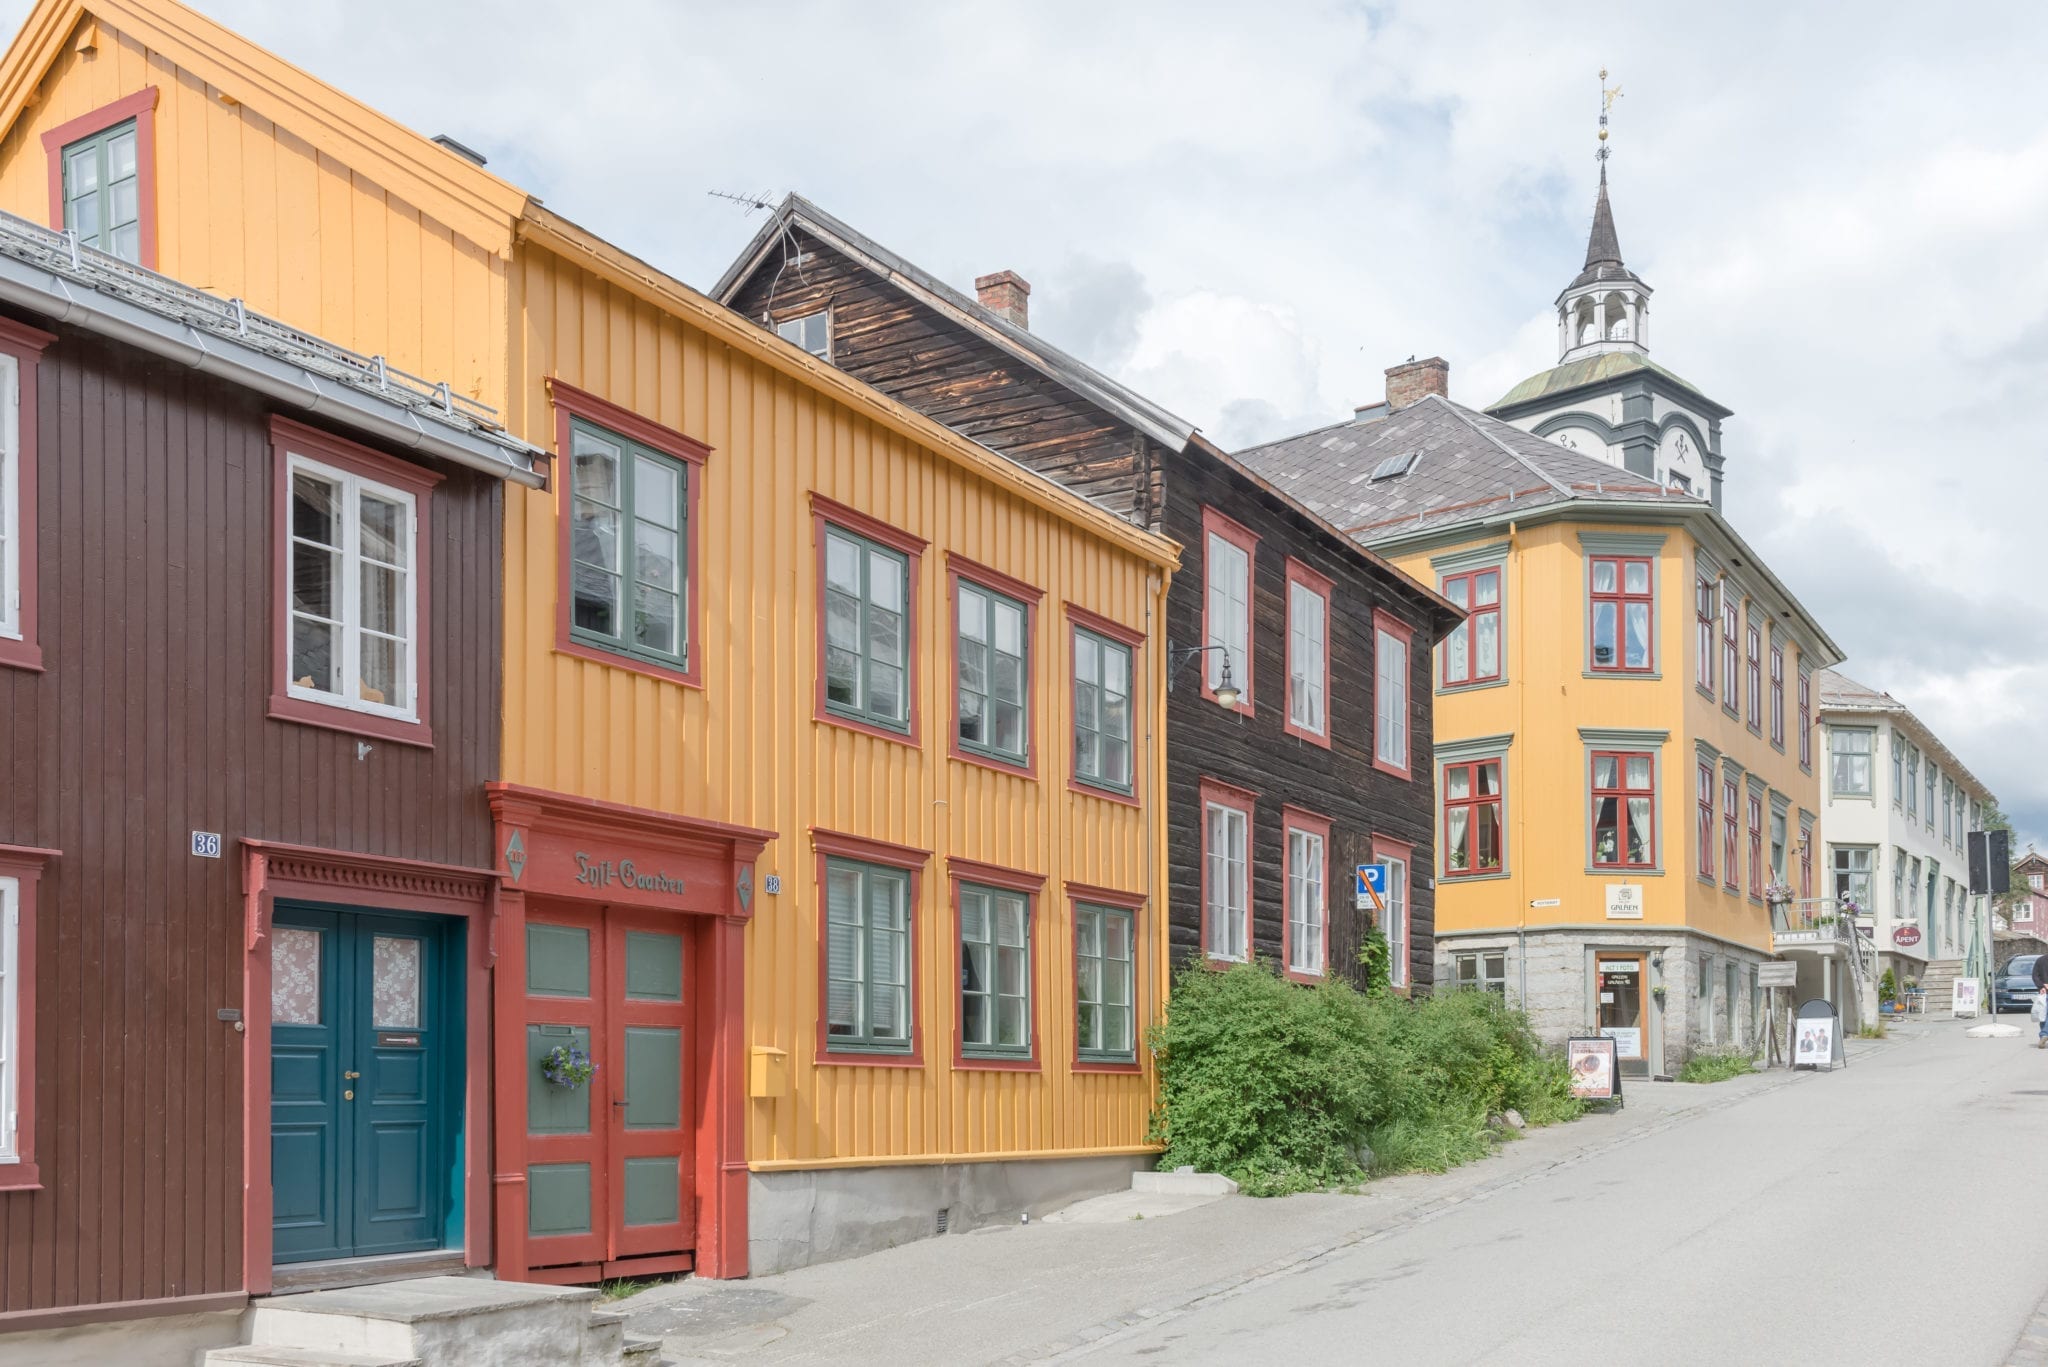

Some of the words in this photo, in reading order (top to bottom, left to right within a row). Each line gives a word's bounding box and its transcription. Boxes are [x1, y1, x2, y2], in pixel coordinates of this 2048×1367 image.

[197, 834, 217, 855] 36
[767, 876, 779, 893] 38
[1364, 868, 1379, 891] P
